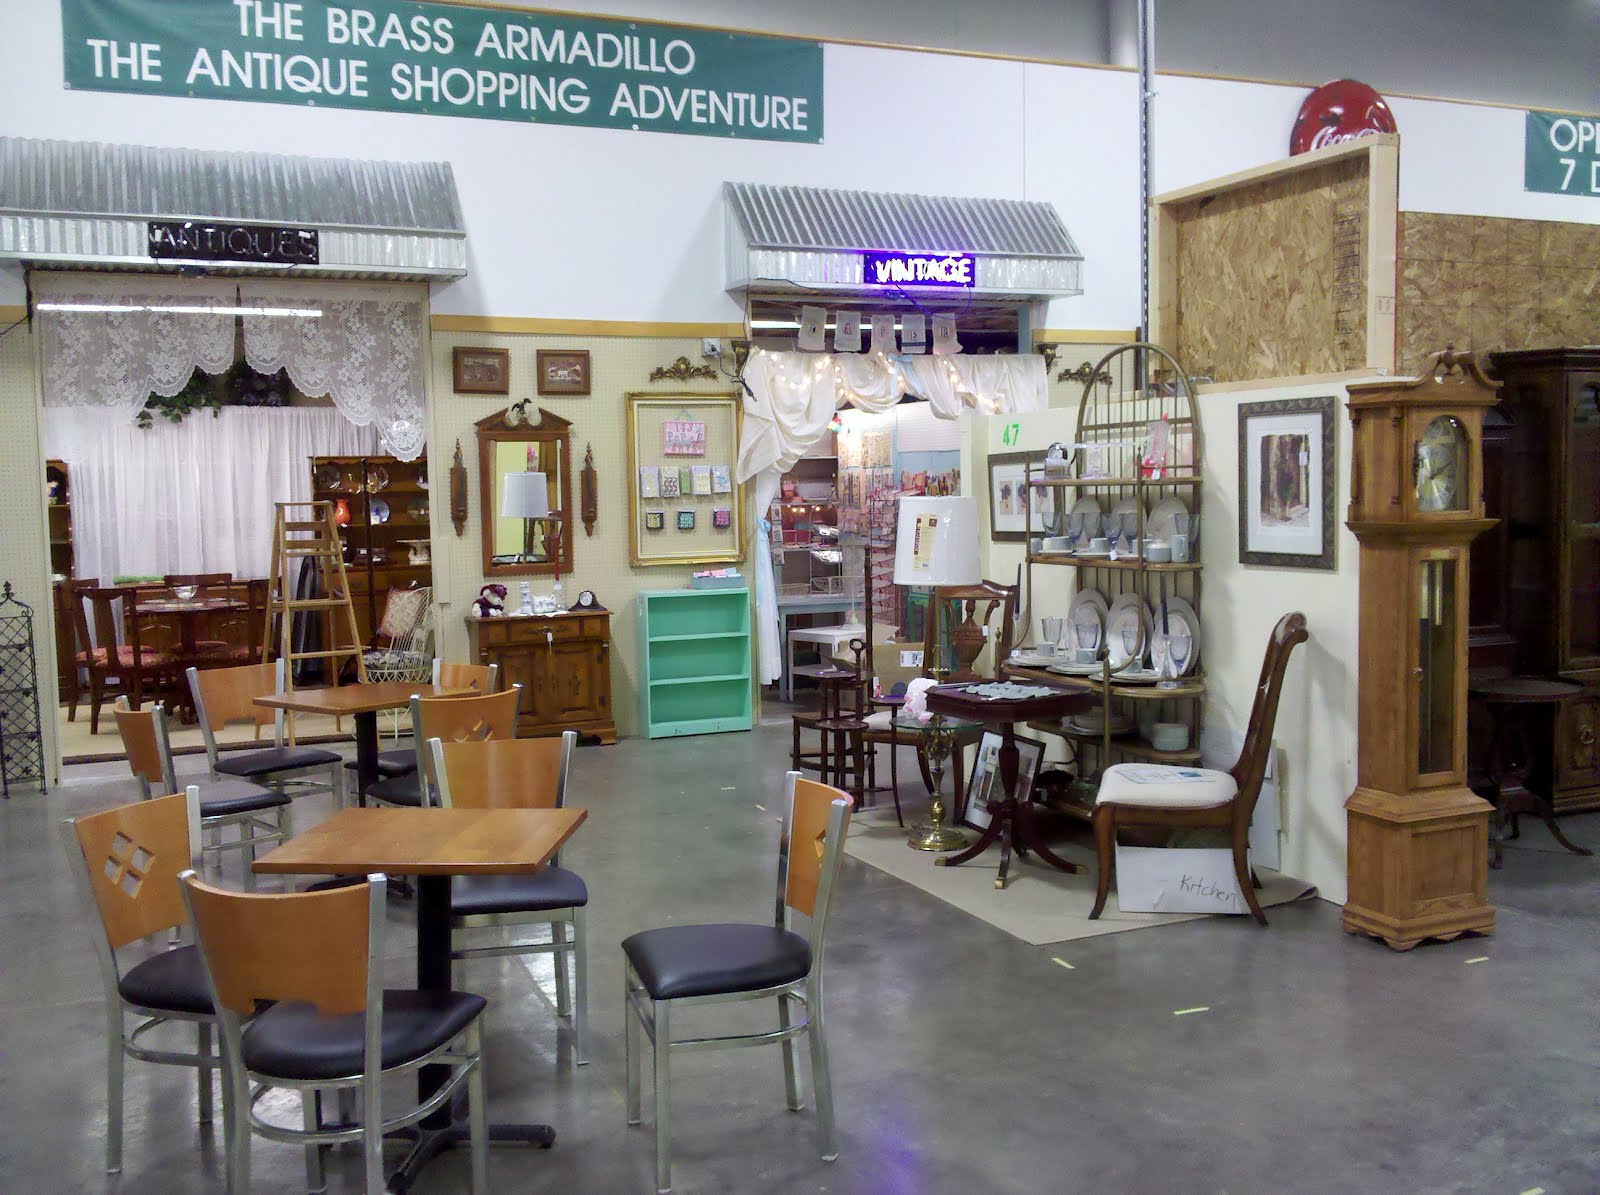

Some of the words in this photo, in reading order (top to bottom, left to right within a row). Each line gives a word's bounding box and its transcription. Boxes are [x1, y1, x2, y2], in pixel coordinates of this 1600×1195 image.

[233, 0, 305, 41] THE
[327, 7, 454, 54] BRASS
[474, 22, 696, 75] ARMADILLO
[86, 38, 162, 82] THE
[185, 47, 369, 97] ANTIQUE
[391, 63, 591, 114] SHOPPING
[609, 83, 808, 131] ADVENTURE
[1560, 158, 1576, 191] 7
[149, 226, 317, 260] ANTIQUES
[873, 257, 972, 283] VINTAGE
[1003, 423, 1020, 446] 47
[1179, 874, 1236, 904] Kitchen
